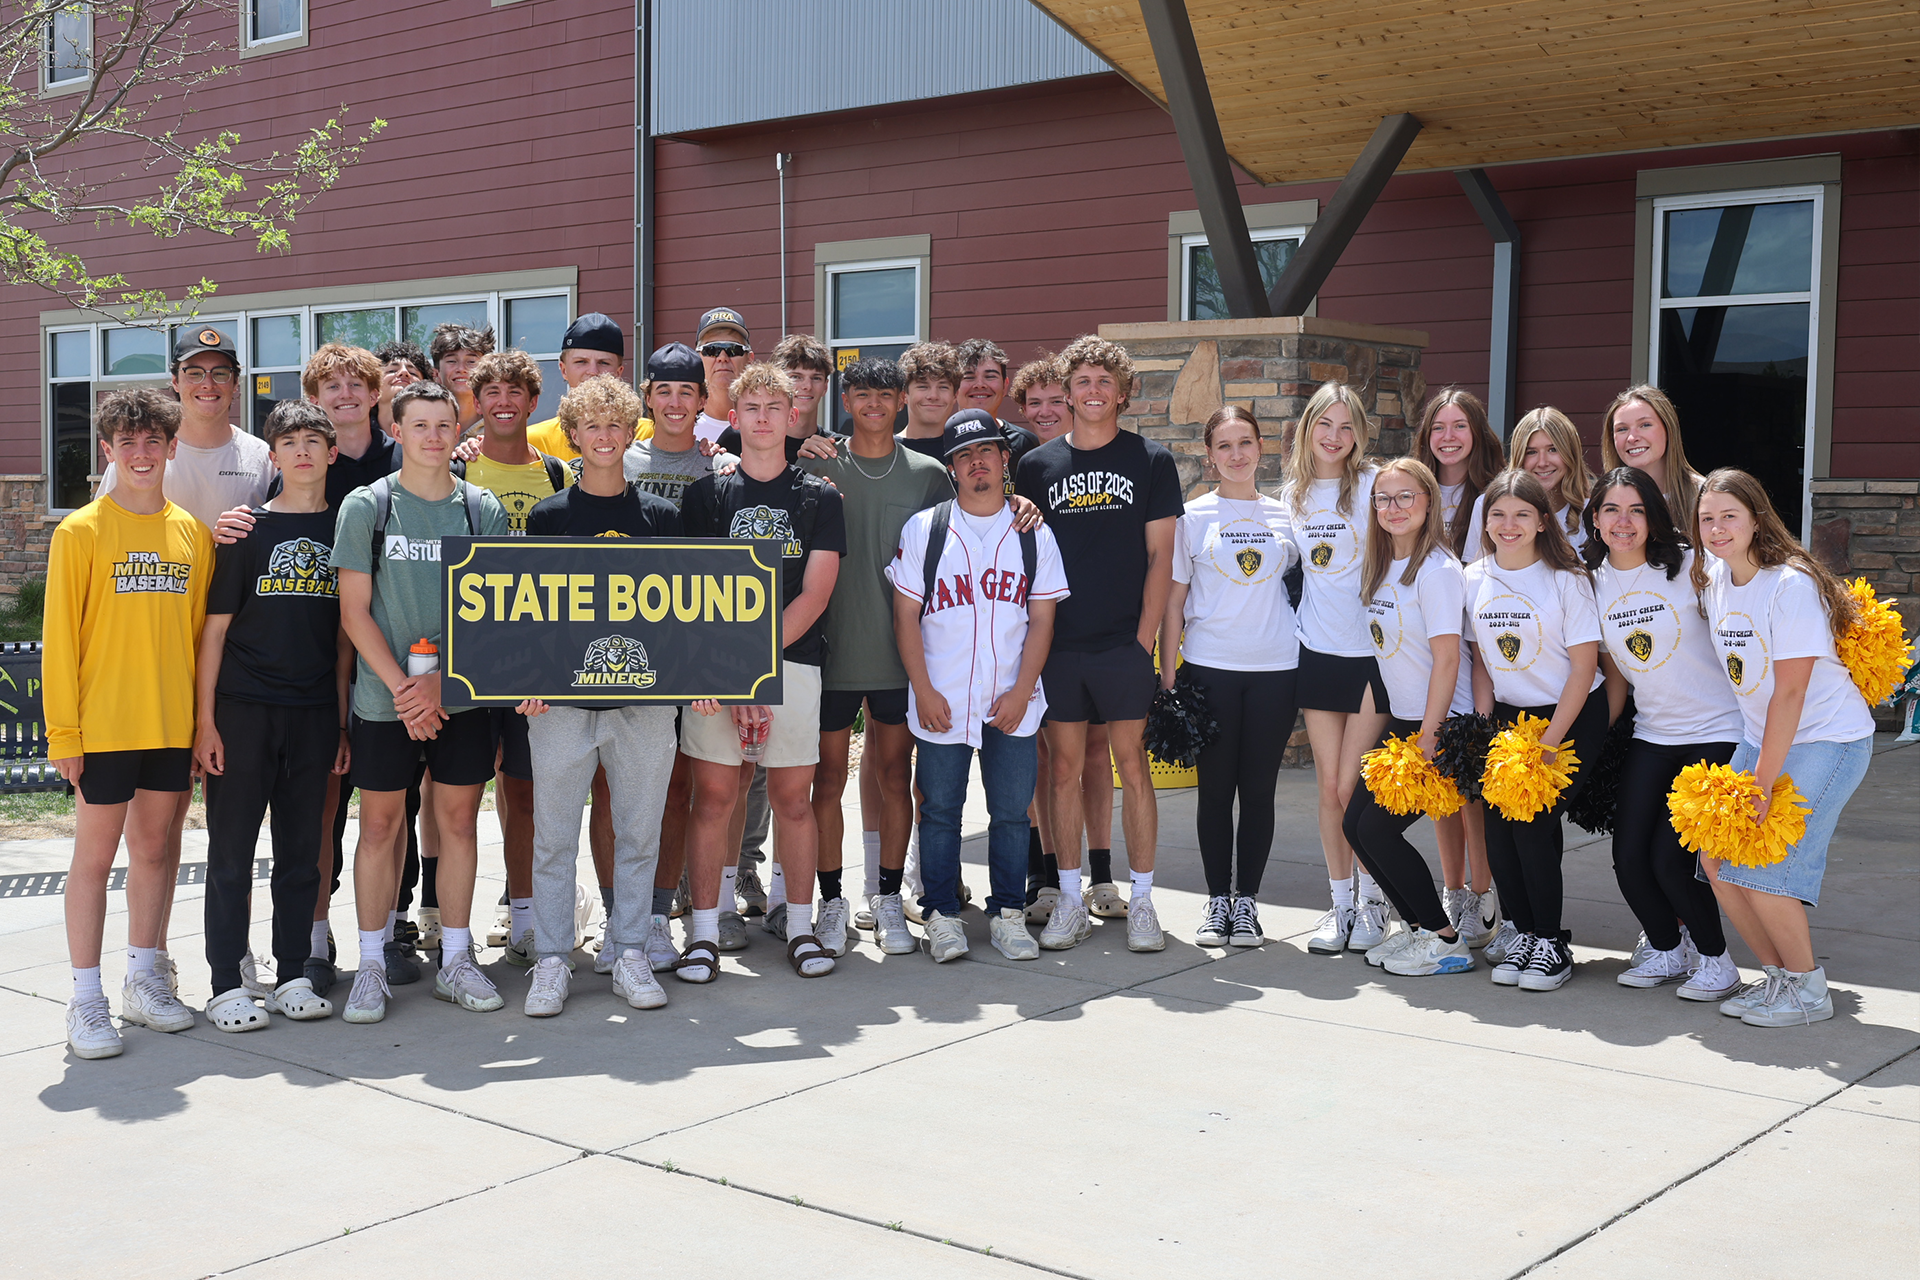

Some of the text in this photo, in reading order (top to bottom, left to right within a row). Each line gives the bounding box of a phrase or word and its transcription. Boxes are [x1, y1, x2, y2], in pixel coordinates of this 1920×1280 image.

[839, 355, 857, 365] 2150
[258, 381, 269, 390] 2149
[955, 419, 985, 436] PRA
[1048, 471, 1134, 511] CLASS OF 2025
[1068, 491, 1114, 508] Senior
[1059, 507, 1084, 515] PROSPECT
[126, 552, 161, 564] PRA
[114, 562, 191, 580] MINERS
[116, 575, 187, 593] BASEBALL
[457, 572, 766, 623] STATE BOUND
[1478, 612, 1531, 620] VARSITY CHEER
[1608, 603, 1666, 622] VARSITY CHEER
[1618, 615, 1654, 628] 2024-2025
[577, 672, 655, 687] MINERS
